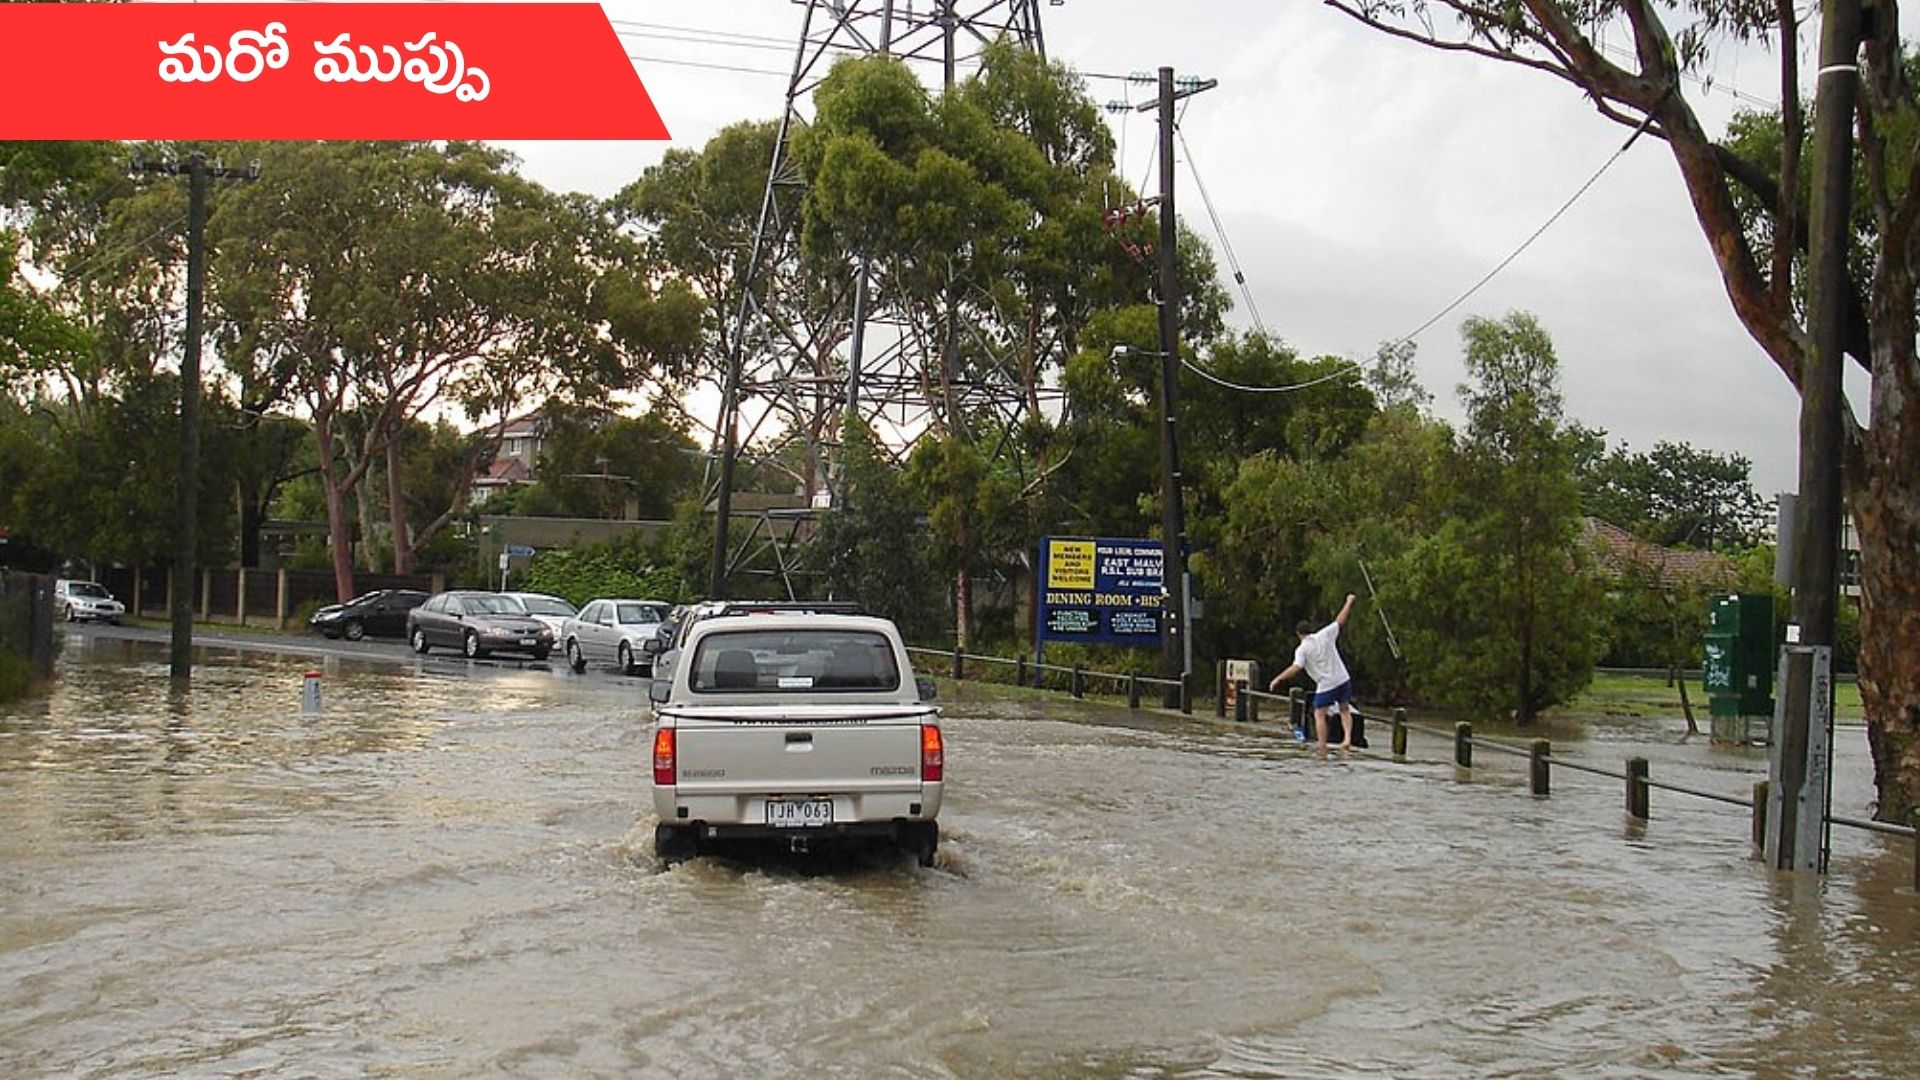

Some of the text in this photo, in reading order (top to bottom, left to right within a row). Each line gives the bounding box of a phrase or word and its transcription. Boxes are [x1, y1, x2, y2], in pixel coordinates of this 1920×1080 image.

[1104, 558, 1130, 568] EAST
[1126, 567, 1144, 576] SUB
[1052, 575, 1091, 583] WELCOME
[1046, 592, 1092, 604] DINING
[1095, 594, 1132, 606] ROOM
[804, 803, 829, 818] 063
